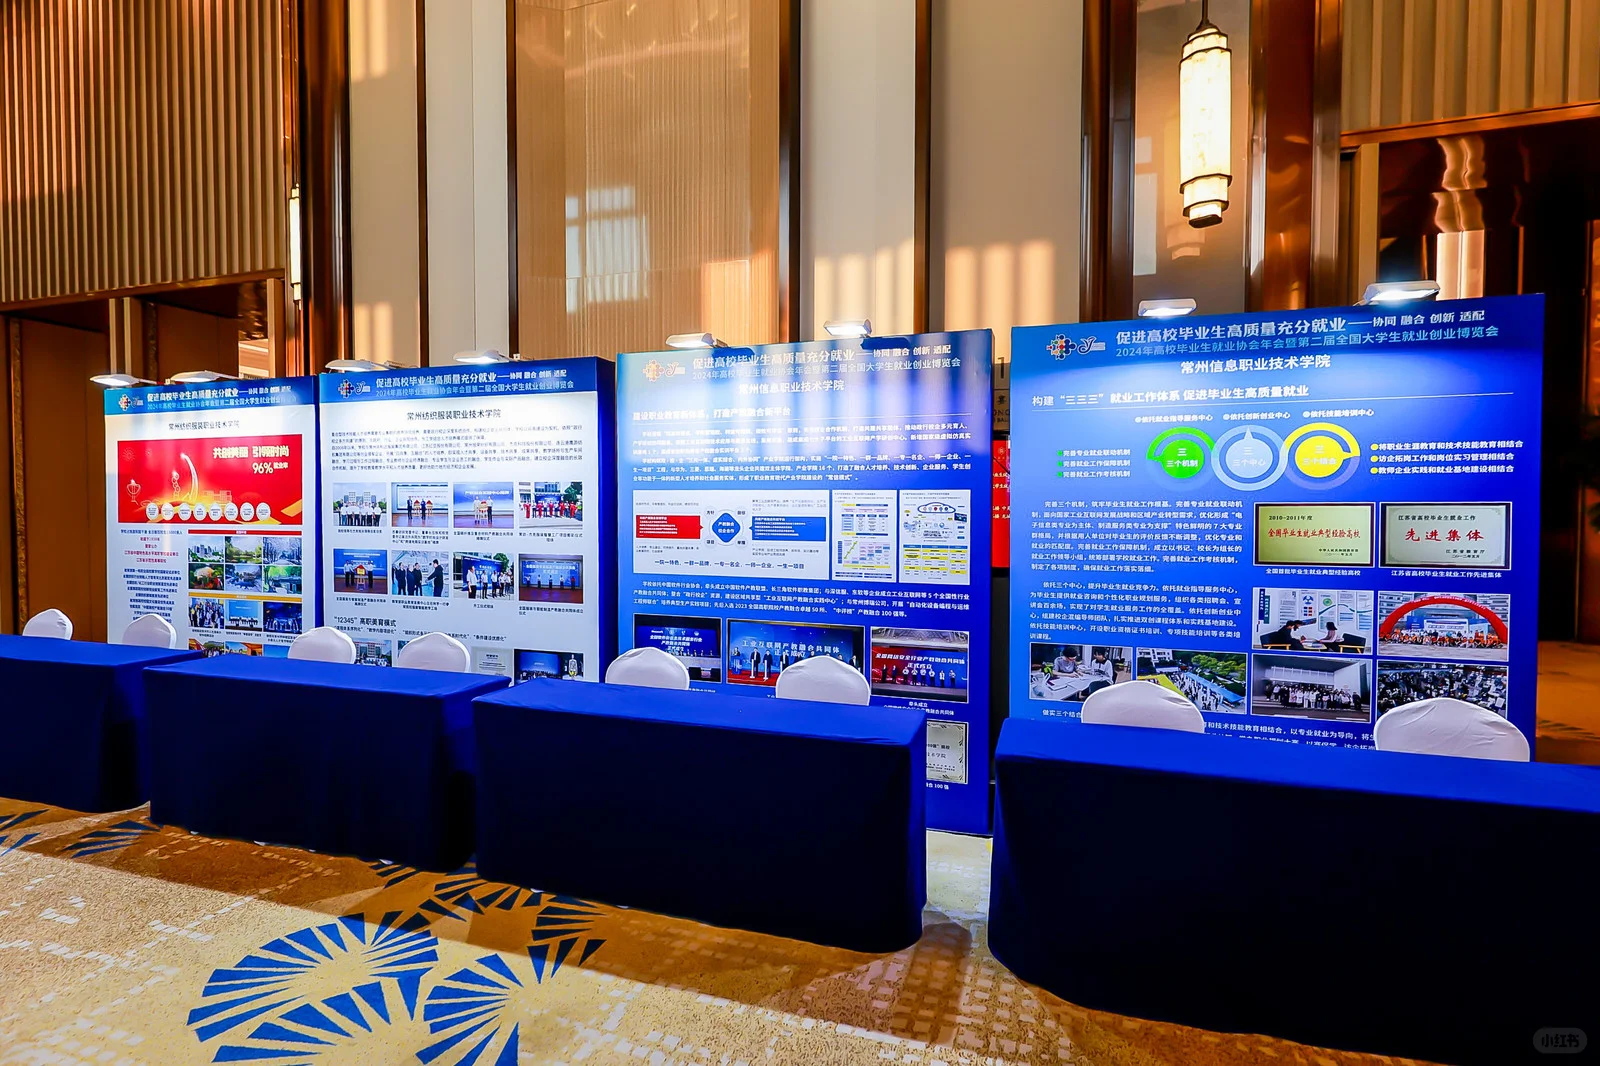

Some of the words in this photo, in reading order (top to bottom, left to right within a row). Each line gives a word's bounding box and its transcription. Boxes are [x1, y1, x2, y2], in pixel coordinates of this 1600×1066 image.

[1400, 314, 1425, 326] 融合
[1430, 312, 1455, 324] 创新
[1459, 310, 1485, 322] 适配
[1116, 326, 1499, 357] 2024年高校毕业生就业协会年会暨第二届全国大学生就业创业博览会
[913, 346, 931, 356] 创新
[933, 344, 952, 354] 适配
[1181, 354, 1331, 375] 常州信息职业技术学院
[739, 379, 845, 395] 常州信息职业技术学院
[1183, 384, 1309, 401] 促进毕业生高质量就业
[407, 409, 502, 421] 常州纺织服装职业技术学院
[252, 445, 290, 457] 引领时尚
[1063, 449, 1131, 457] 完善专业就业联动机制
[252, 462, 274, 474] 96%
[1166, 459, 1199, 468] 三个机制
[1232, 458, 1266, 467] 三个中心
[1268, 528, 1361, 539] 全国毕业生就业典型经验高校
[1405, 528, 1484, 541] 先进集体
[1391, 570, 1502, 579] 江苏省高校毕业生就业工作先进集体
[742, 640, 840, 653] 工业互联网产教融合共同体
